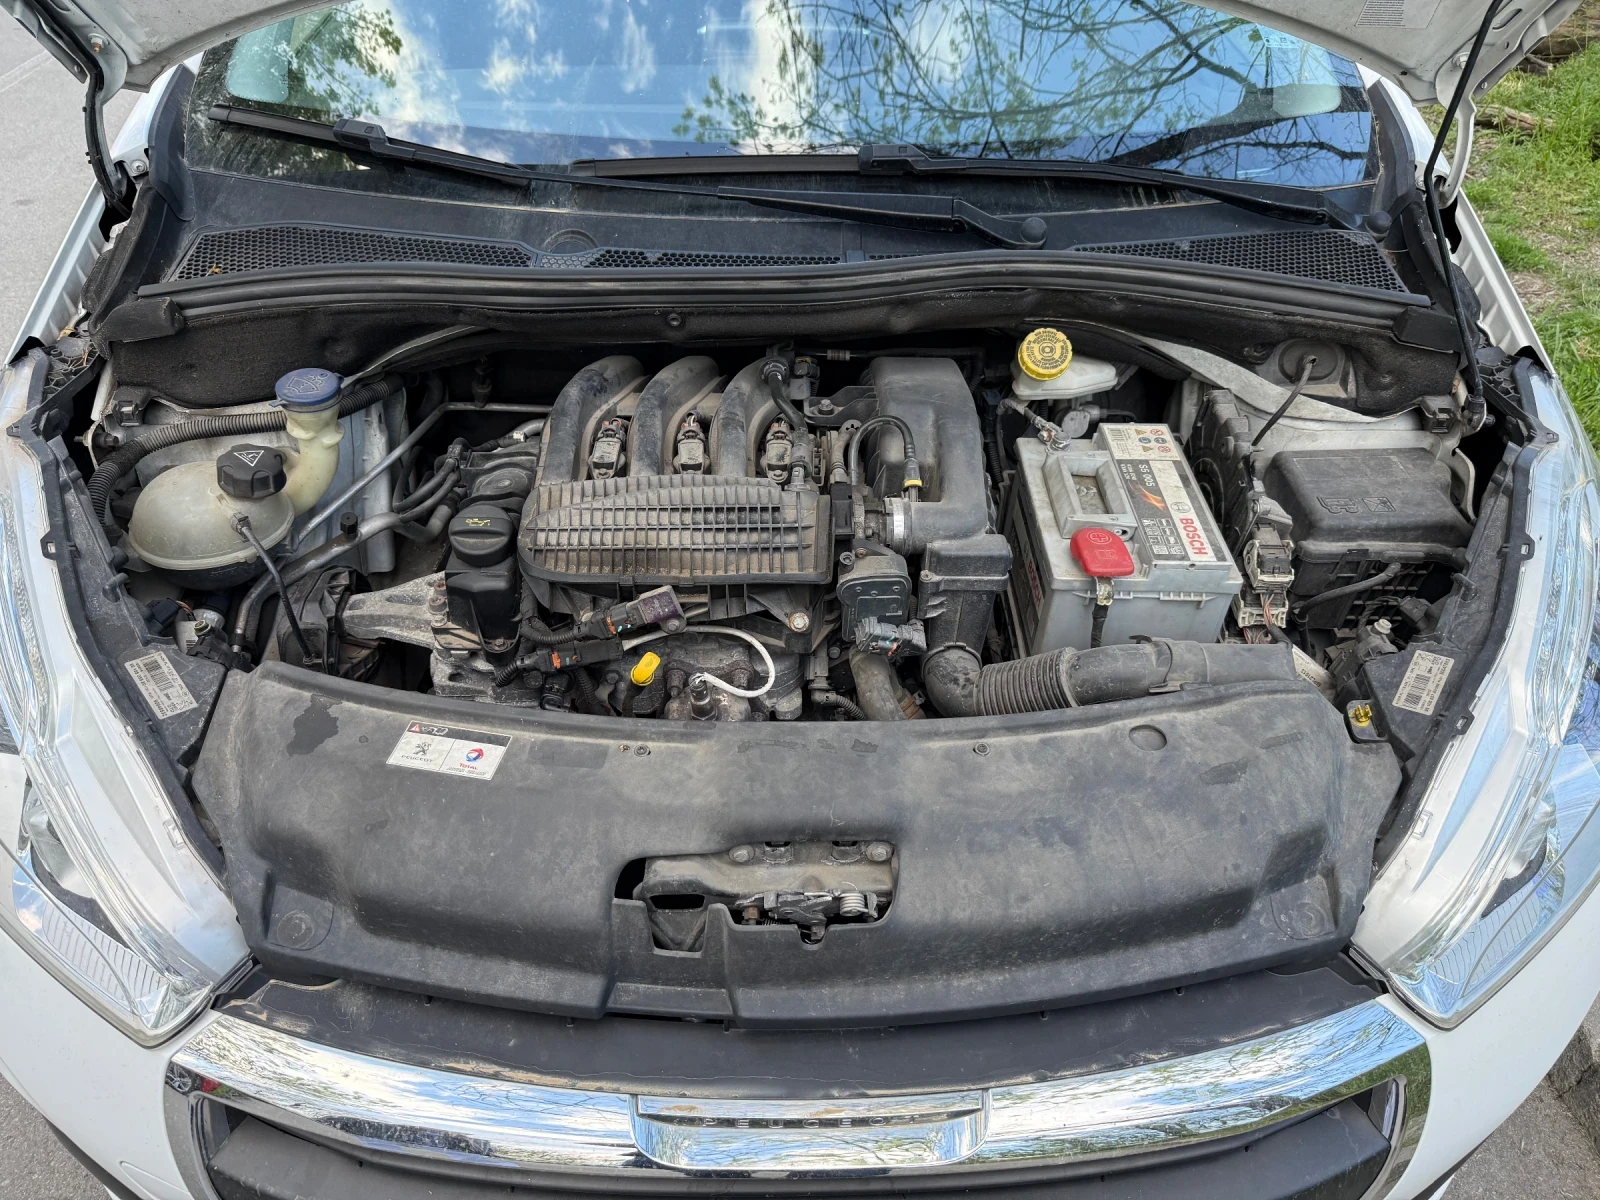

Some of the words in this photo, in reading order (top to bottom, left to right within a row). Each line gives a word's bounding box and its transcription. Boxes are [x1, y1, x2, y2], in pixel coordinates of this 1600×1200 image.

[1138, 464, 1150, 473] S5
[1142, 473, 1156, 487] 005
[1179, 517, 1209, 555] BOSCH
[401, 754, 433, 763] PEUGEOT
[459, 762, 478, 770] TOTAL
[702, 1115, 919, 1129] PEUGEOT
